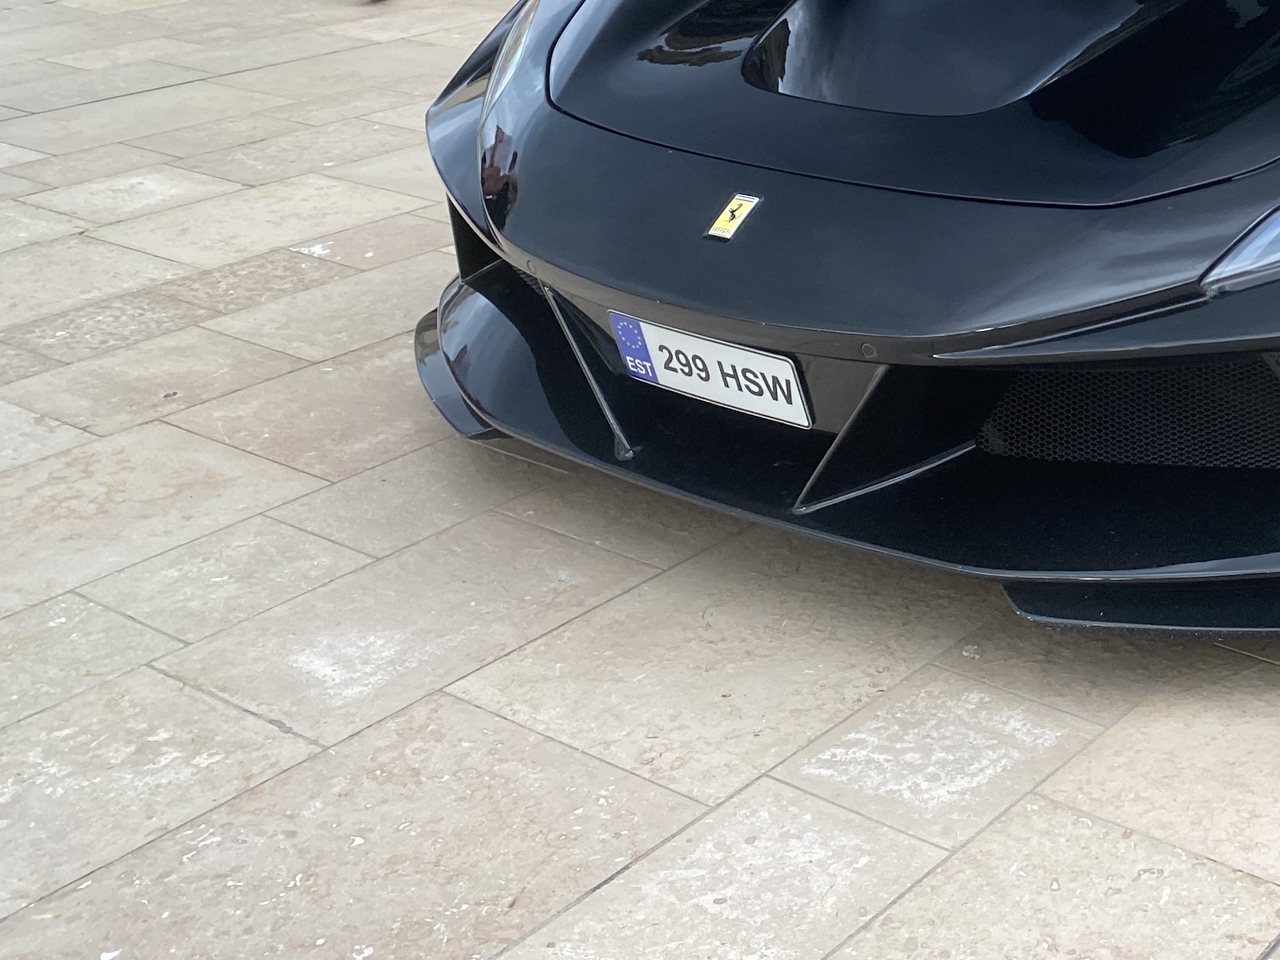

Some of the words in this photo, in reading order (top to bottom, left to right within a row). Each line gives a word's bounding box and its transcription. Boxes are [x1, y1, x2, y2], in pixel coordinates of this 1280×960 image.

[626, 355, 652, 377] EST
[658, 344, 710, 382] 299
[716, 360, 793, 405] HSW
